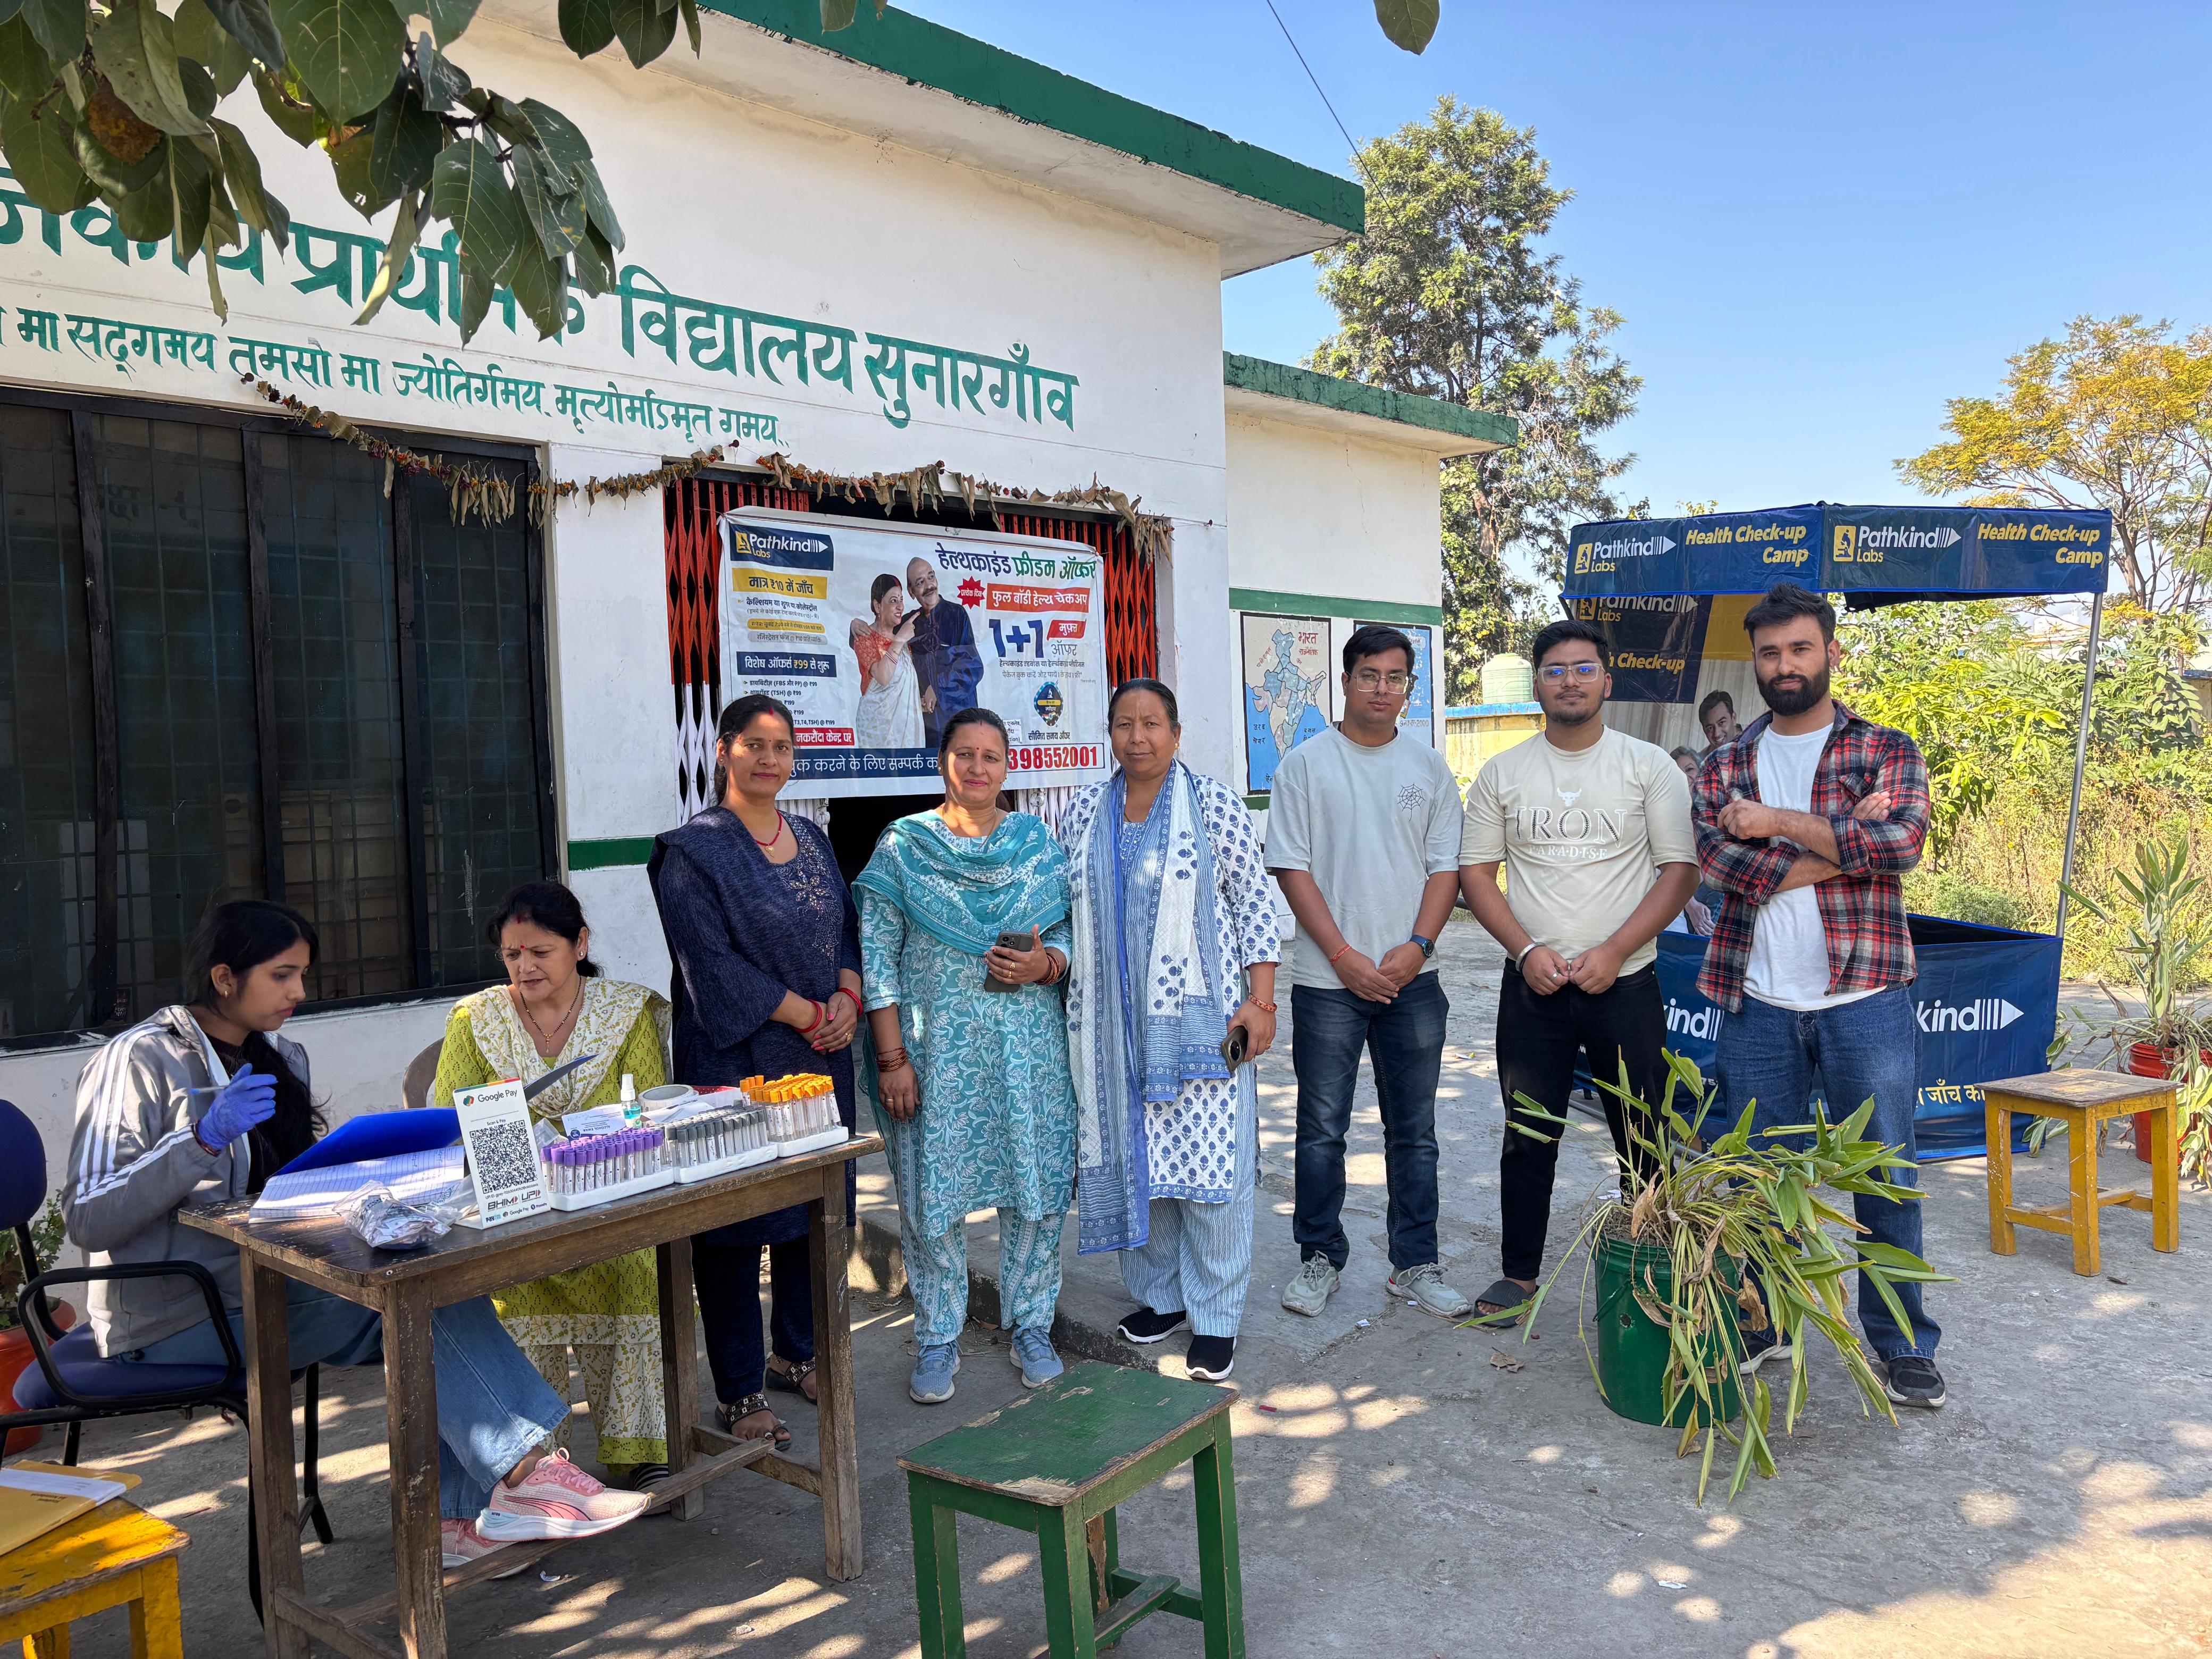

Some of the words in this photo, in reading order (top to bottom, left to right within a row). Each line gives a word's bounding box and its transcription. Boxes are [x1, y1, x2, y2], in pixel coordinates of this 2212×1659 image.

[16, 307, 62, 354] मा
[228, 336, 332, 389] तमसो
[340, 353, 381, 396] मा
[613, 264, 857, 395] विद्यालय
[864, 332, 1079, 432] सुनारगाँव
[749, 533, 810, 552] Pathkind
[1686, 526, 1733, 545] Health
[1735, 523, 1806, 544] Check-up
[1858, 525, 1939, 548] Pathkind
[1978, 523, 2026, 541] Health
[2030, 524, 2100, 547] Check-up
[752, 548, 771, 558] Labs
[1593, 536, 1654, 559] Pathkind
[1763, 546, 1808, 567] Camp
[1857, 549, 1884, 563] Labs
[2055, 547, 2103, 568] Camp
[1011, 551, 1055, 578] फ्रीडम
[1059, 556, 1097, 580] ऑफर
[1591, 560, 1615, 573] Labs
[749, 576, 769, 588] मात्र
[770, 579, 784, 591] ₹10
[785, 578, 794, 592] में
[796, 580, 814, 594] जाँच
[746, 597, 773, 606] कैल्शियम
[992, 590, 1011, 607] फुल
[1013, 589, 1032, 605] बॉडी
[1033, 590, 1053, 606] हेल्थ
[1597, 609, 1622, 622] Labs
[988, 619, 1044, 658] 1+1
[1051, 640, 1078, 656] ऑफर
[744, 656, 766, 668] विशेष
[768, 656, 792, 668] ऑफर्स
[793, 659, 808, 669] ₹99
[810, 657, 816, 669] से
[817, 661, 830, 673] शुरू
[1617, 652, 1686, 674] Check-up
[795, 729, 824, 743] नकरौंदा
[843, 733, 852, 743] पर
[813, 755, 847, 772] करने
[848, 755, 860, 771] के
[862, 754, 886, 771] लिए
[887, 753, 923, 770] सम्पर्क
[1008, 746, 1097, 770] 398552001
[1515, 806, 1628, 848] IRON
[477, 1091, 504, 1102] Google
[1925, 1078, 1962, 1104] जाँच
[488, 1196, 515, 1210] BHIM
[522, 1189, 538, 1200] UPI
